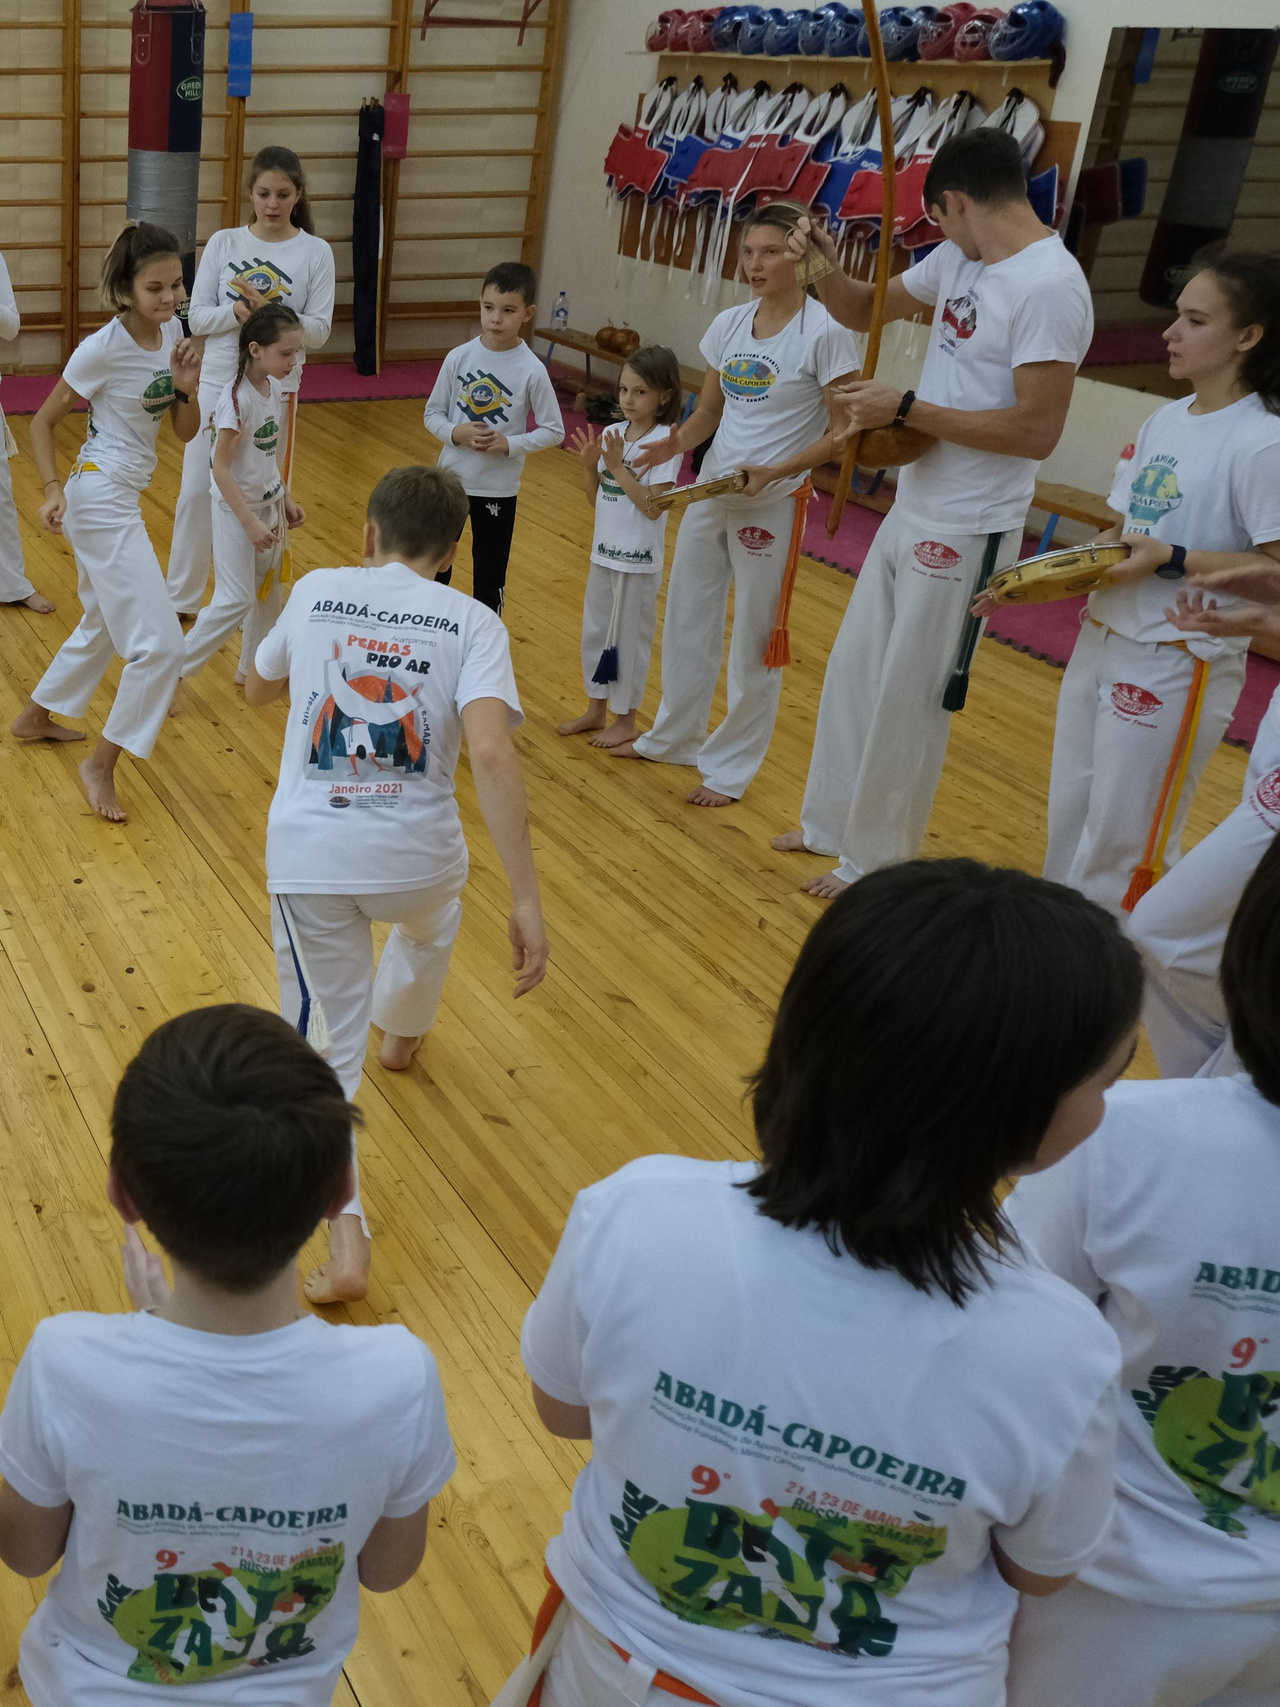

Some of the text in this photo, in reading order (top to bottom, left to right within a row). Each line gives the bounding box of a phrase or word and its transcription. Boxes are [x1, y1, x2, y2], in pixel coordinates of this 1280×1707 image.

[860, 160, 880, 170] KWON
[916, 157, 934, 165] KWO
[311, 600, 459, 636] ABADÁ-CAPOEIRA
[347, 634, 412, 656] PERNAS
[390, 636, 437, 647] Acampamento
[366, 652, 431, 675] PRO AR
[329, 783, 403, 794] Janeiro 2021
[654, 1370, 967, 1501] ABADÁ-CAPOEIRA
[785, 1481, 805, 1496] 21
[807, 1491, 818, 1504] A
[819, 1491, 841, 1508] 23
[841, 1500, 862, 1516] DE
[117, 1499, 348, 1530] ABADÁ-CAPOEIRA
[230, 1546, 244, 1556] 21
[246, 1549, 254, 1558] A
[256, 1552, 271, 1564] 23
[272, 1555, 287, 1566] DE
